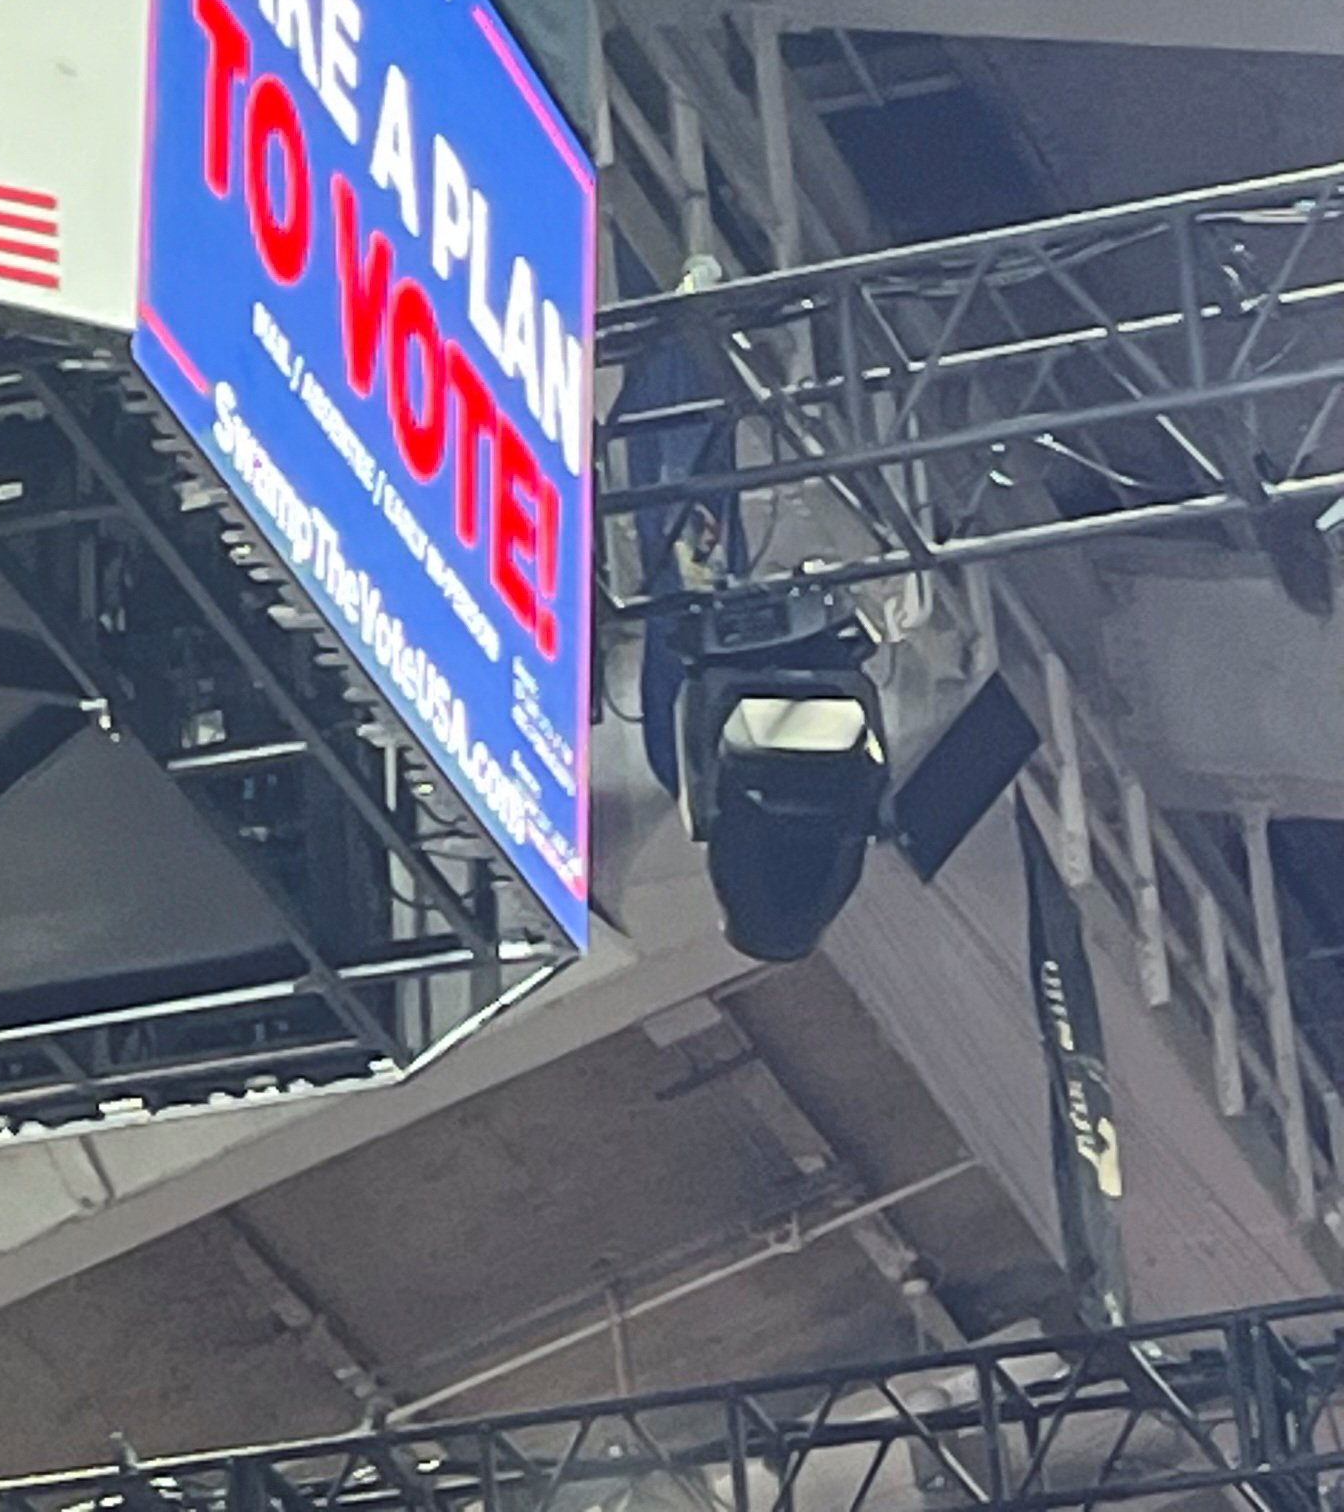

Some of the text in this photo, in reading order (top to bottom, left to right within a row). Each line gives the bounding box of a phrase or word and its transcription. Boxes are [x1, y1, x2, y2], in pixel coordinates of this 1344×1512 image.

[330, 170, 562, 662] VOTE!
[369, 64, 420, 238] A
[430, 131, 582, 477] PLAN
